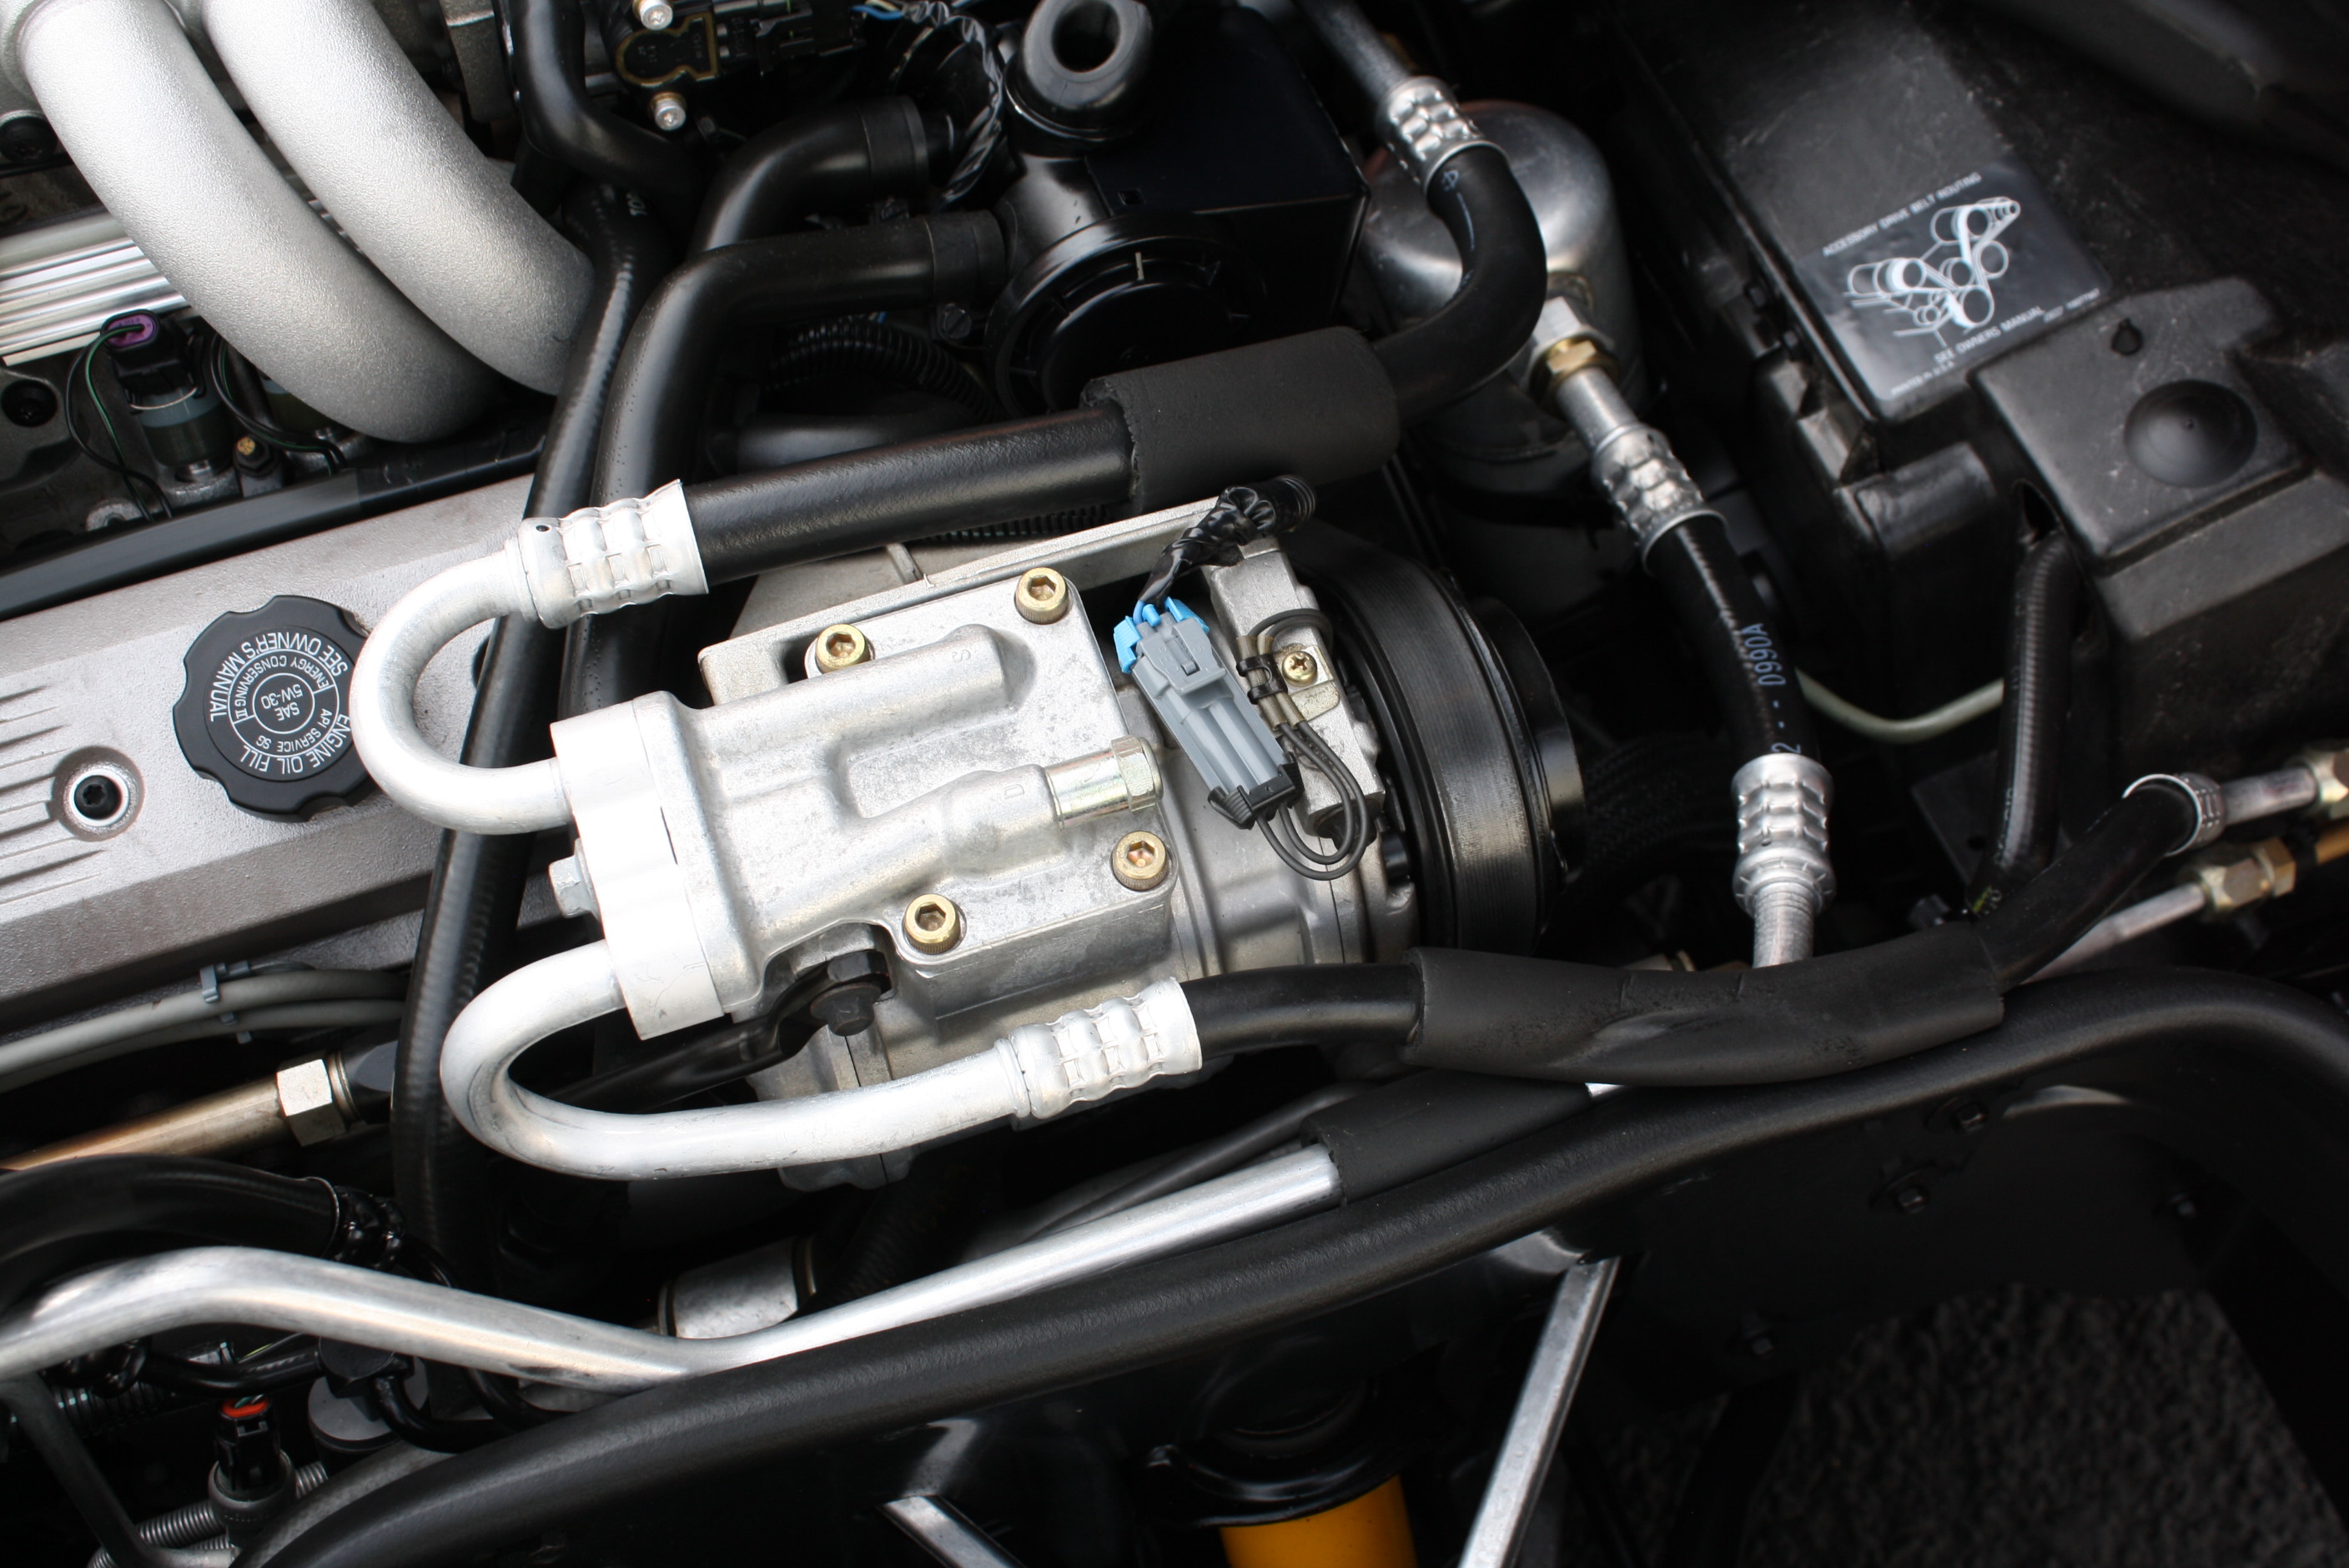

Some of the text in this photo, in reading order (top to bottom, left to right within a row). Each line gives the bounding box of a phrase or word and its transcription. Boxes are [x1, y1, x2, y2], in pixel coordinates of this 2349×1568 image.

[1823, 172, 1982, 257] ACCESSORY DRIVE BELT ROUTING
[1934, 347, 1956, 364] SEE
[2000, 305, 2044, 331] MANUAL
[209, 632, 349, 722] SEE OWNER'S MANUAL
[234, 655, 287, 707] CONSERVING
[260, 684, 304, 709] 5W-30
[290, 656, 329, 689] ENERGY
[256, 708, 333, 752] API SERVICE SG
[274, 701, 300, 721] SAE
[240, 714, 351, 775] ENGINE OIL FILL
